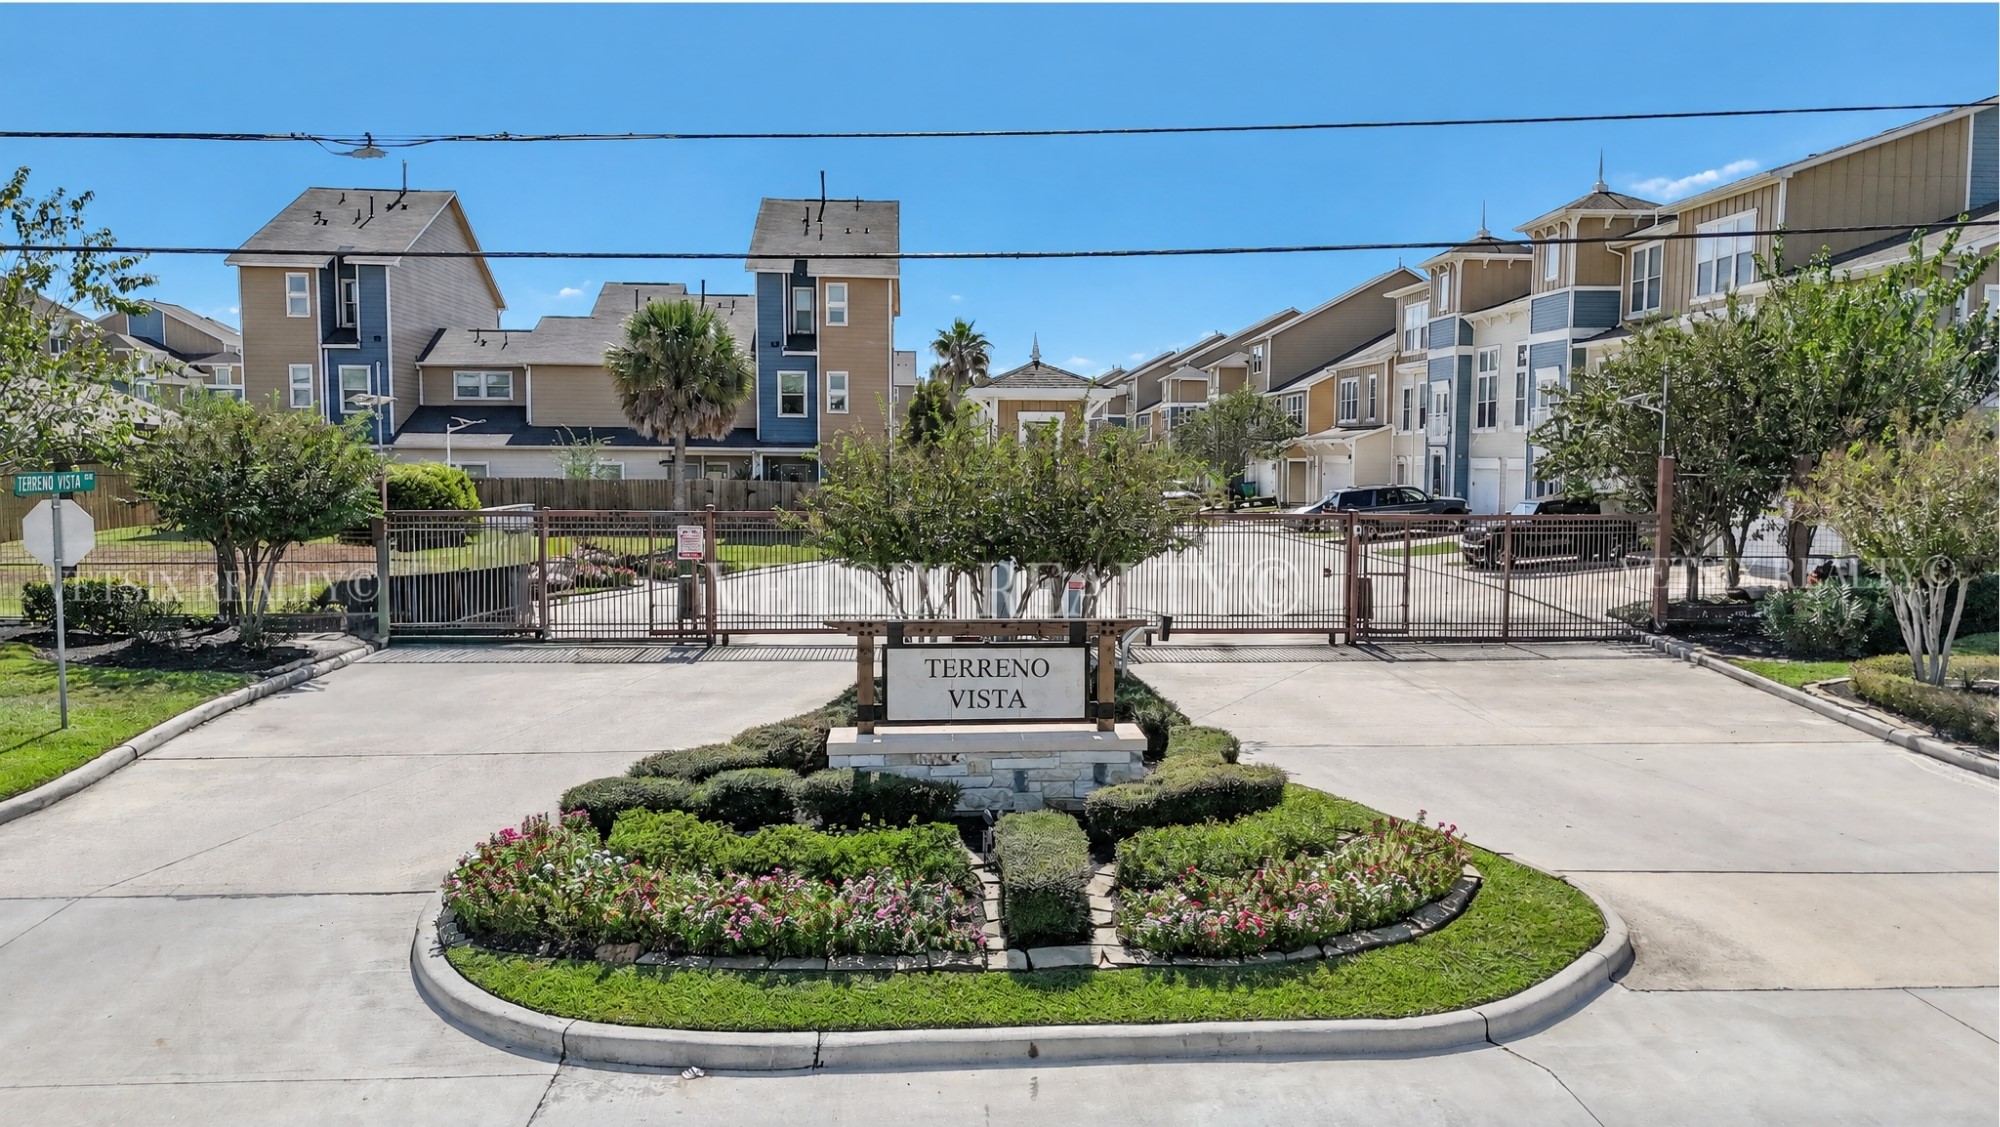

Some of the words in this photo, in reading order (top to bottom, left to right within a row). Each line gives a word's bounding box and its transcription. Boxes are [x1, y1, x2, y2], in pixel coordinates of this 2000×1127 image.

[17, 475, 54, 492] TERRENO
[57, 474, 81, 490] VISTA
[924, 657, 1050, 679] TERRENO
[948, 688, 1028, 709] VISTA
